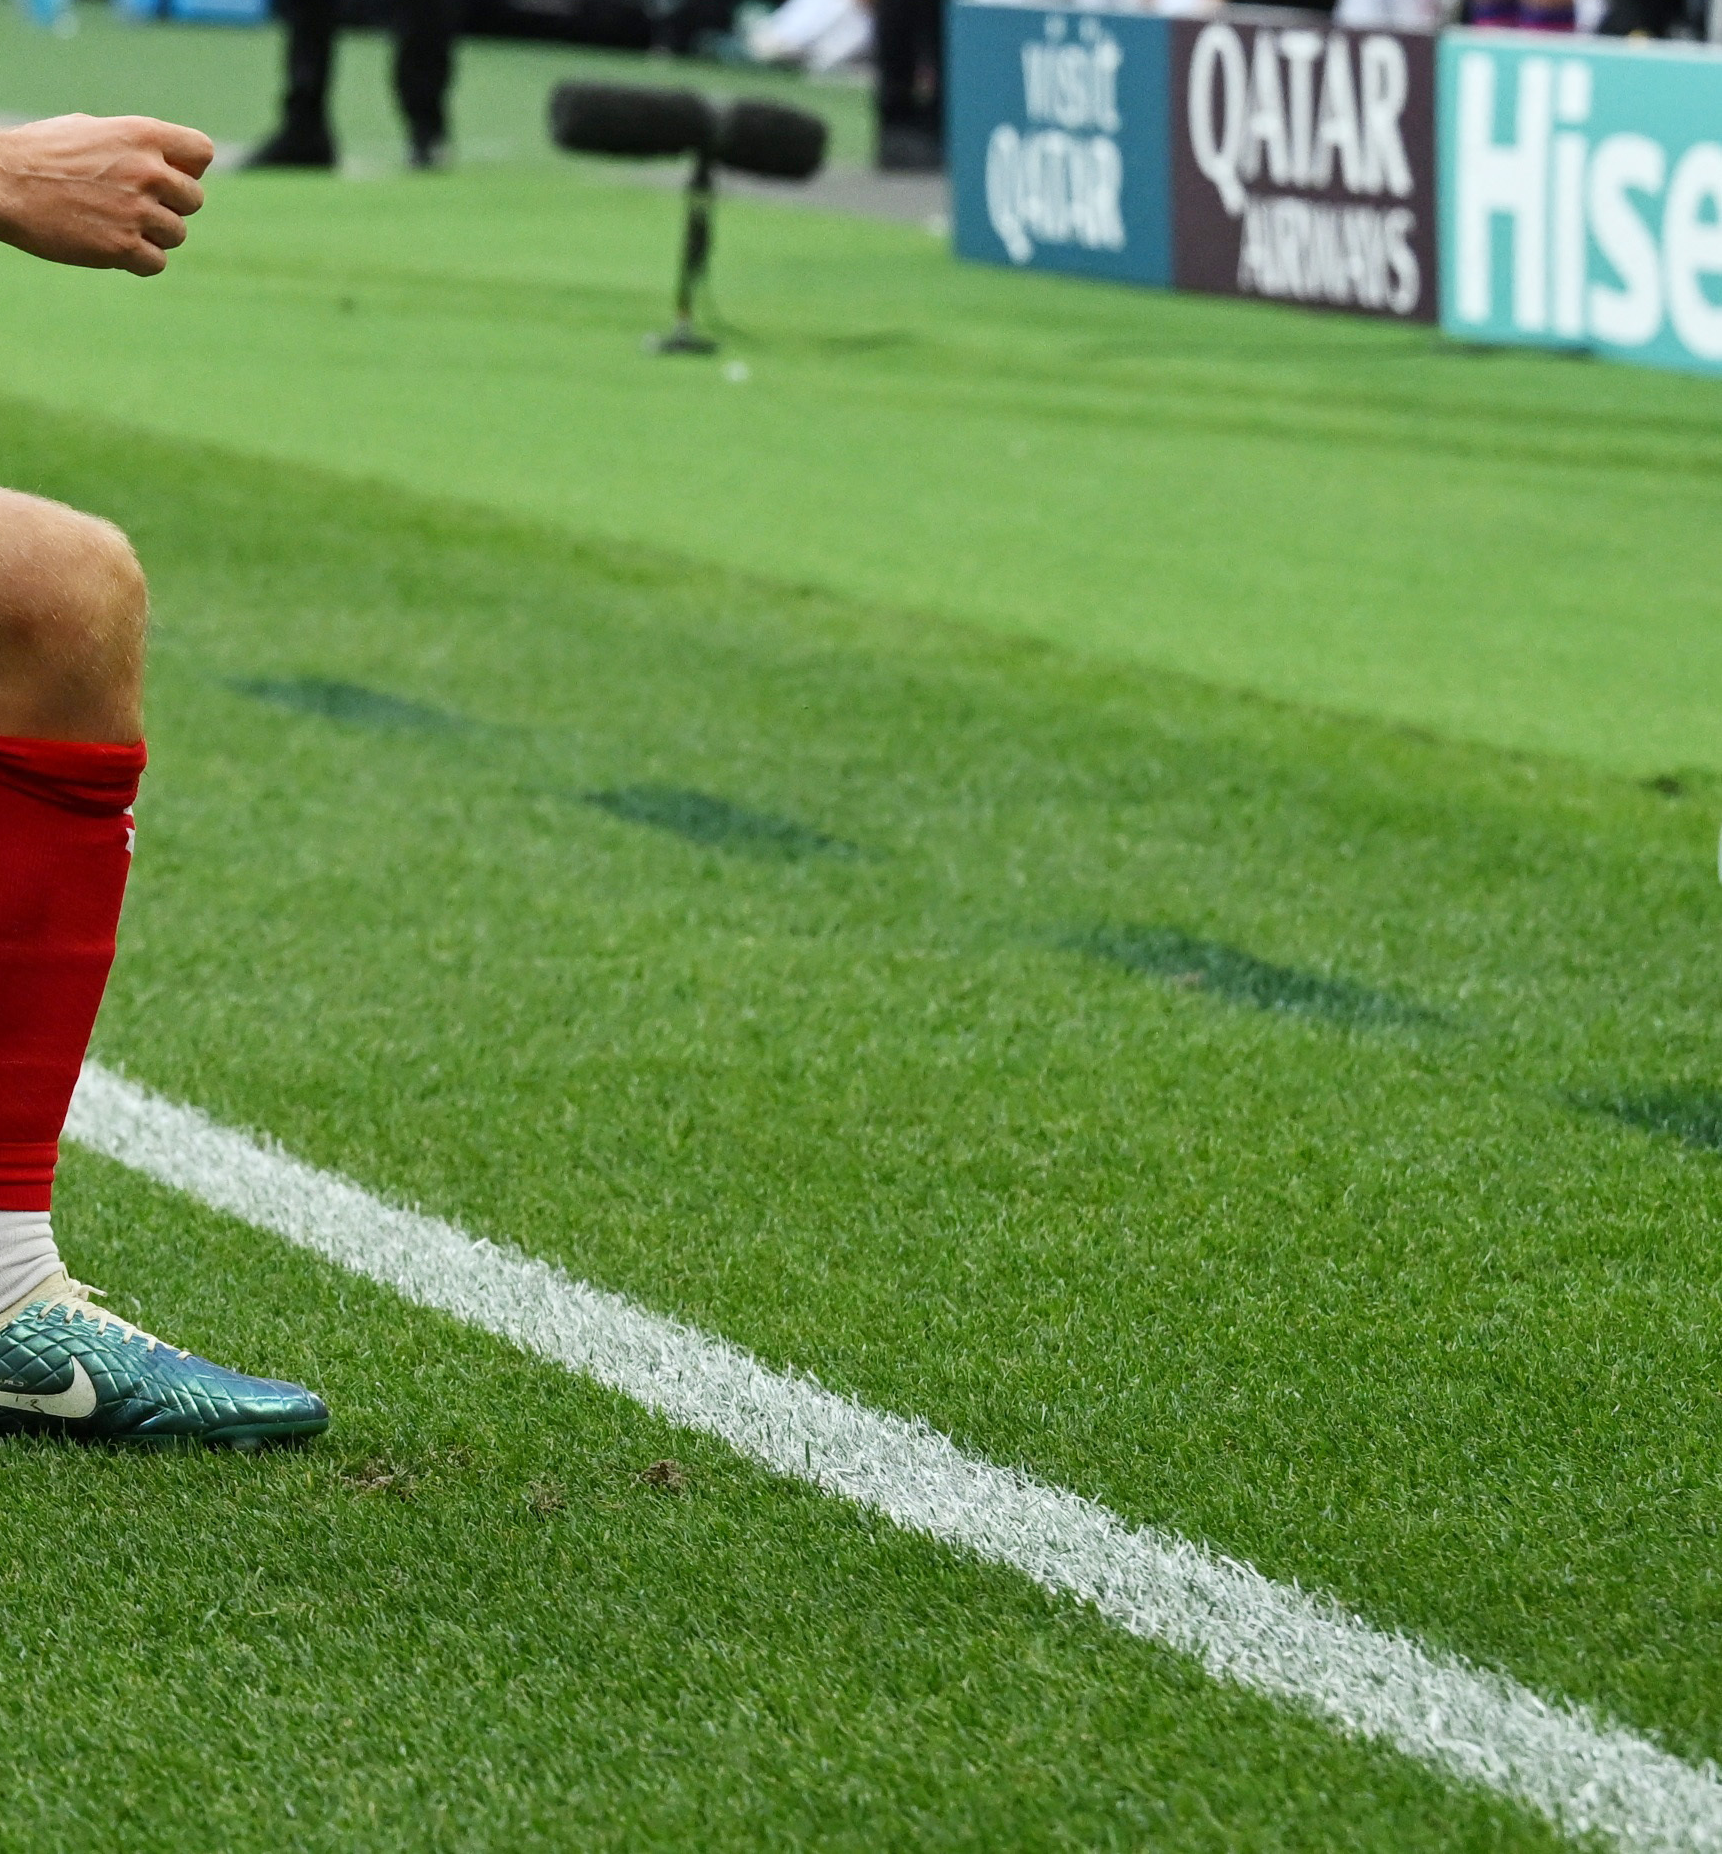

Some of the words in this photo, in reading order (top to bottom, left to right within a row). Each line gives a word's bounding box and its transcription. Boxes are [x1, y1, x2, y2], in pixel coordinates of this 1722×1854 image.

[1188, 23, 1415, 218] QATAR
[986, 122, 1127, 266] QATAR
[1236, 197, 1421, 315] AIRWAYS
